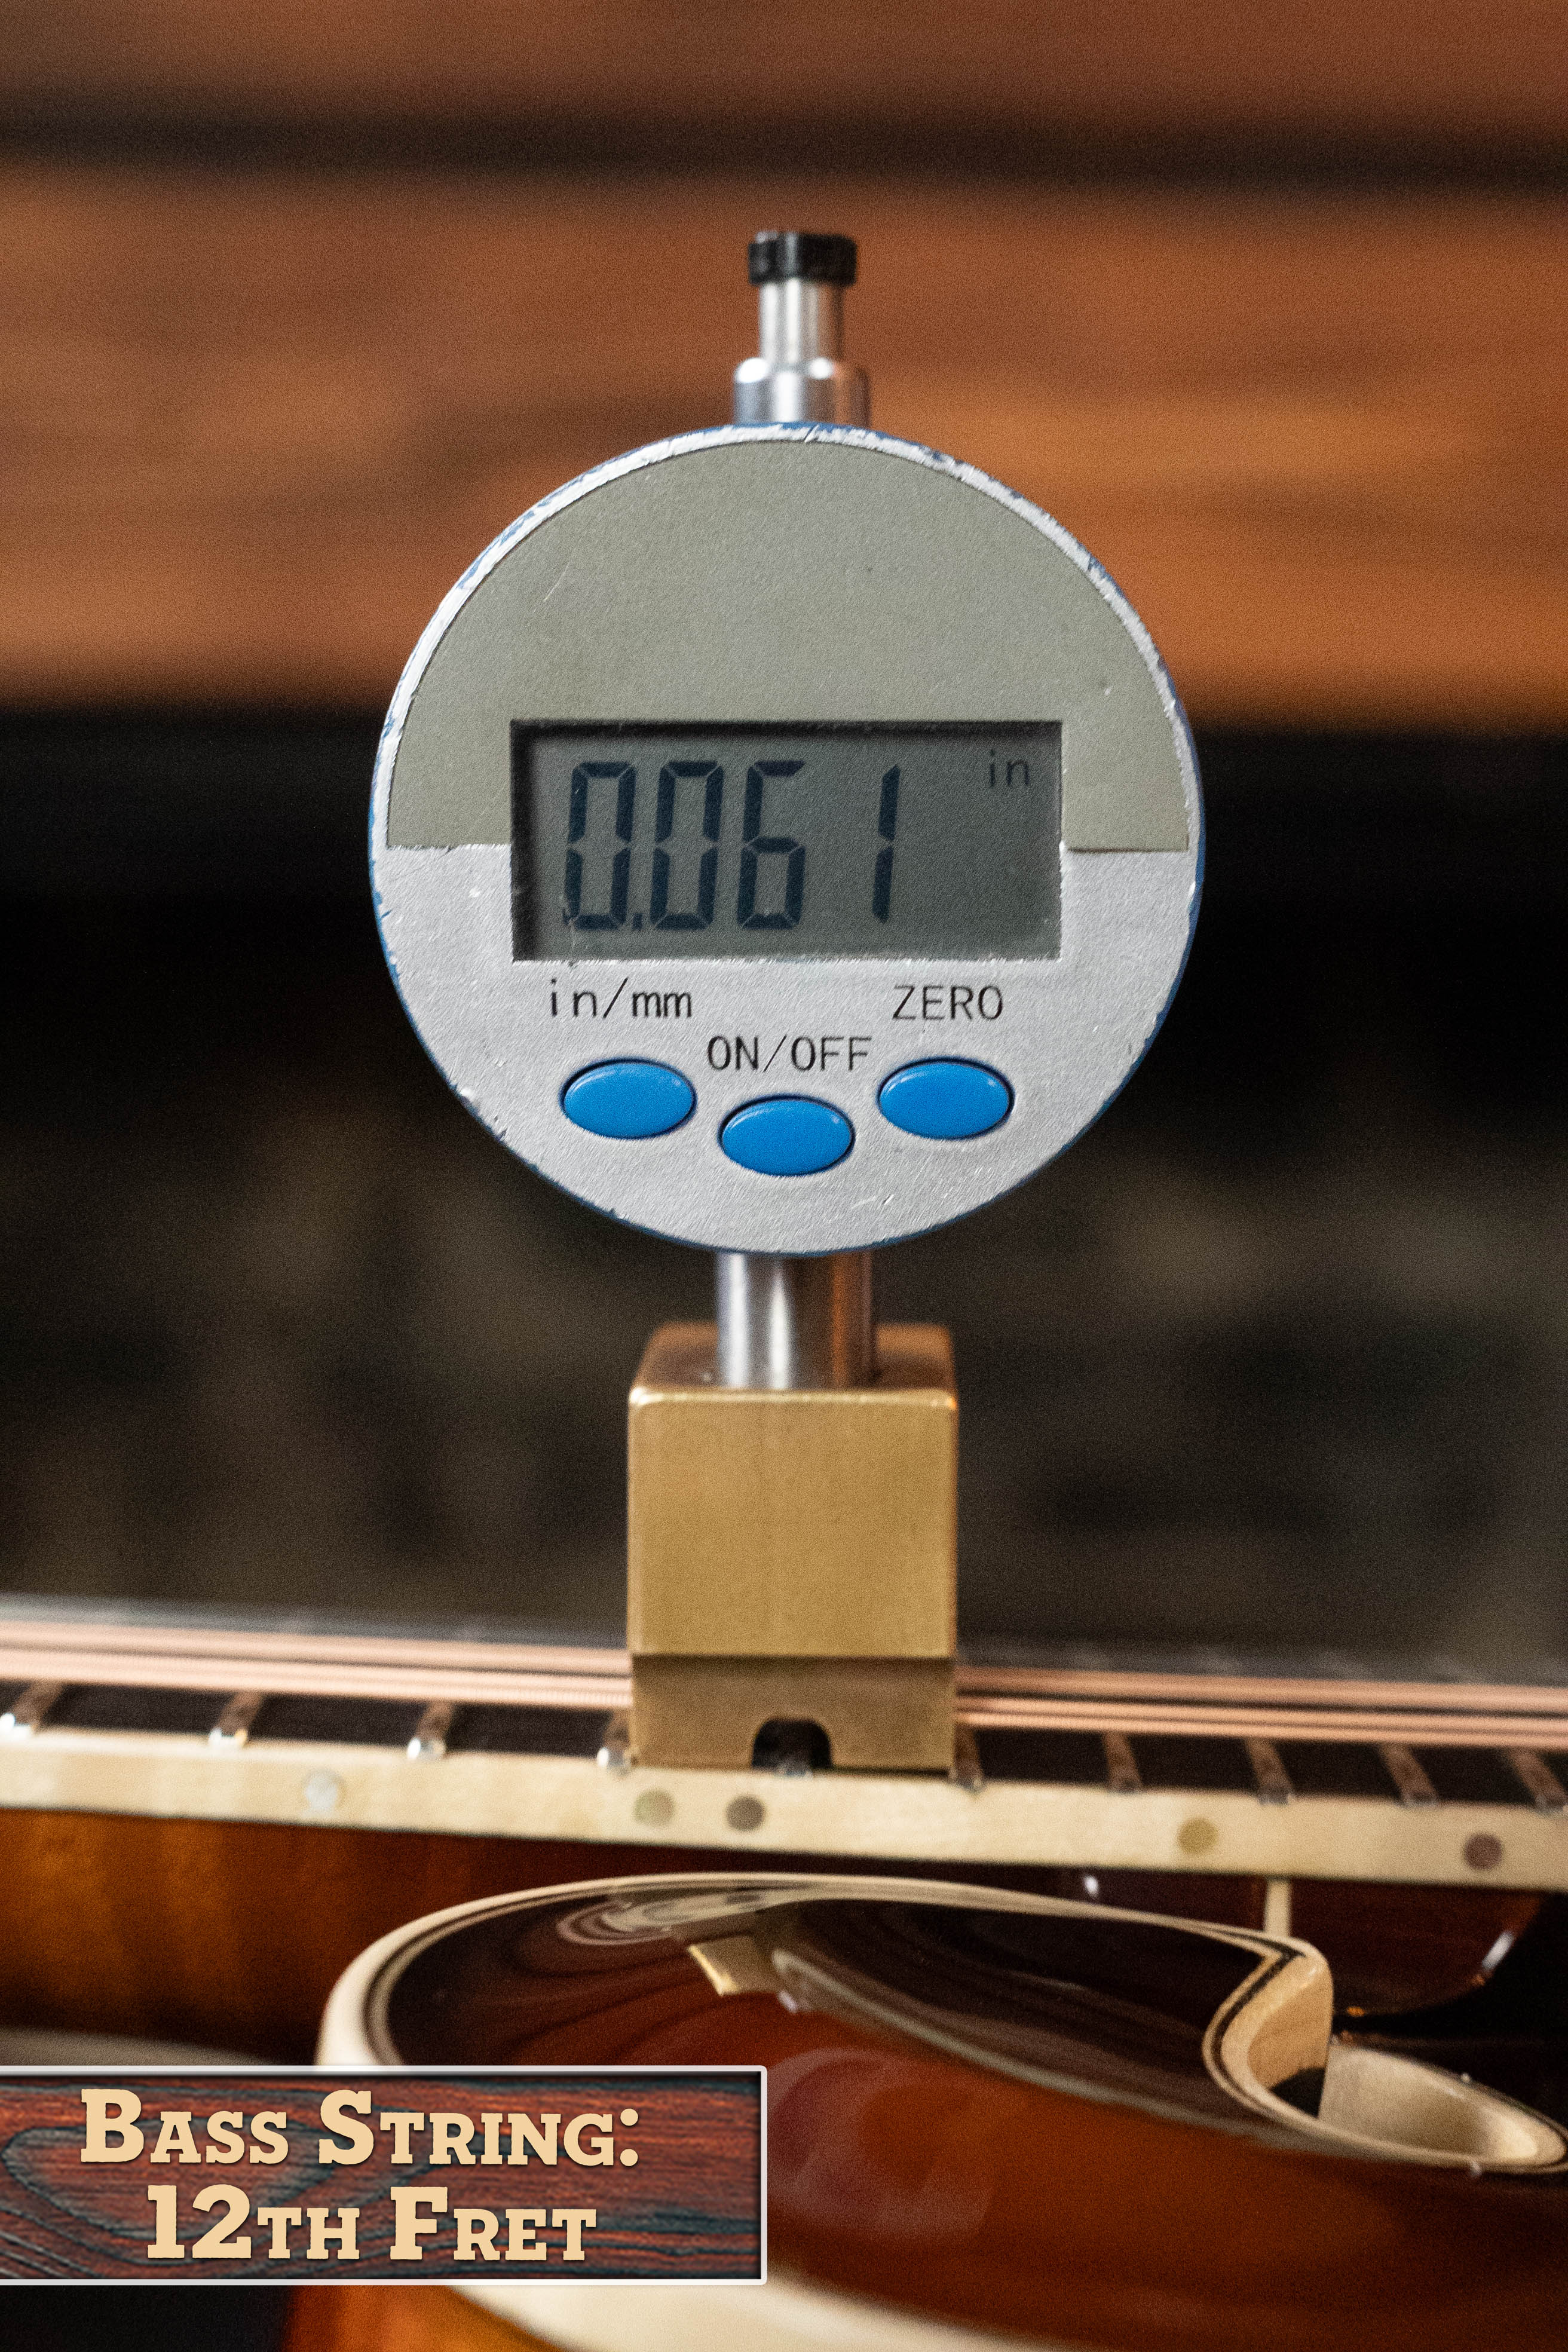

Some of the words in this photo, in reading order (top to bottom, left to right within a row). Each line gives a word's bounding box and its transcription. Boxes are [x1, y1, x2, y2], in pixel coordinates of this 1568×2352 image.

[987, 748, 1032, 789] in
[565, 760, 901, 931] 0.061
[550, 977, 693, 1019] in/mm
[891, 984, 1004, 1021] ZERO
[706, 1035, 872, 1073] ON/OFF
